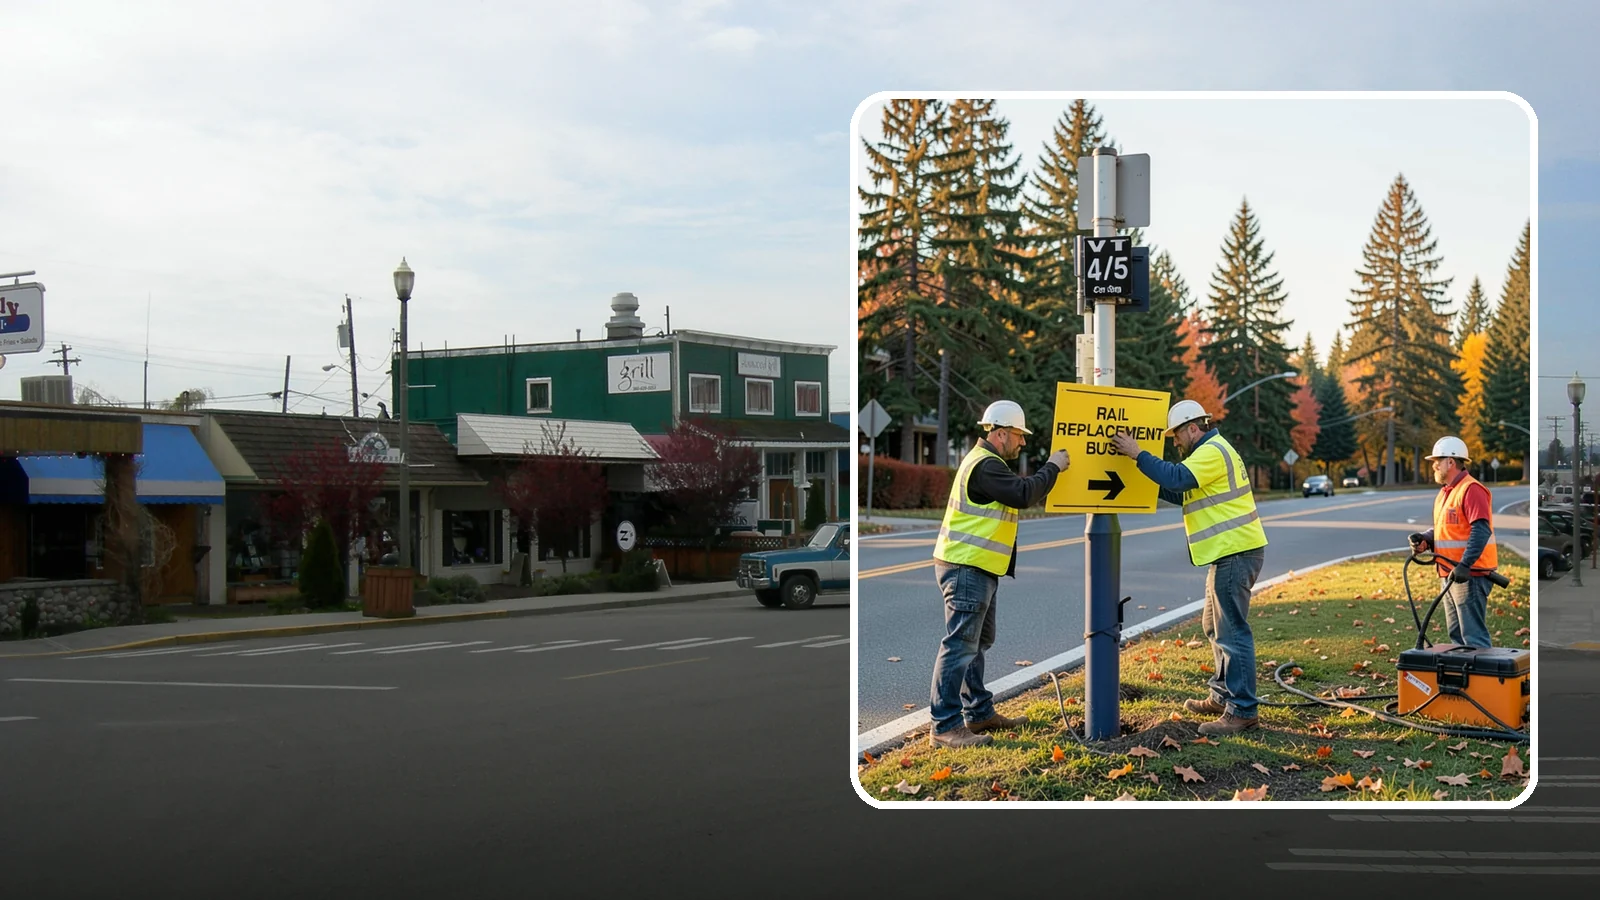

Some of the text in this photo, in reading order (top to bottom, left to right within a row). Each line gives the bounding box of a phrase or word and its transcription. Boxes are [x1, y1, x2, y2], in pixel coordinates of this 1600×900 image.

[1087, 255, 1128, 280] 4/5
[618, 356, 654, 391] grill
[1096, 406, 1129, 421] RAIL
[1056, 422, 1164, 440] REPLACEMENT
[1086, 441, 1127, 456] BUS
